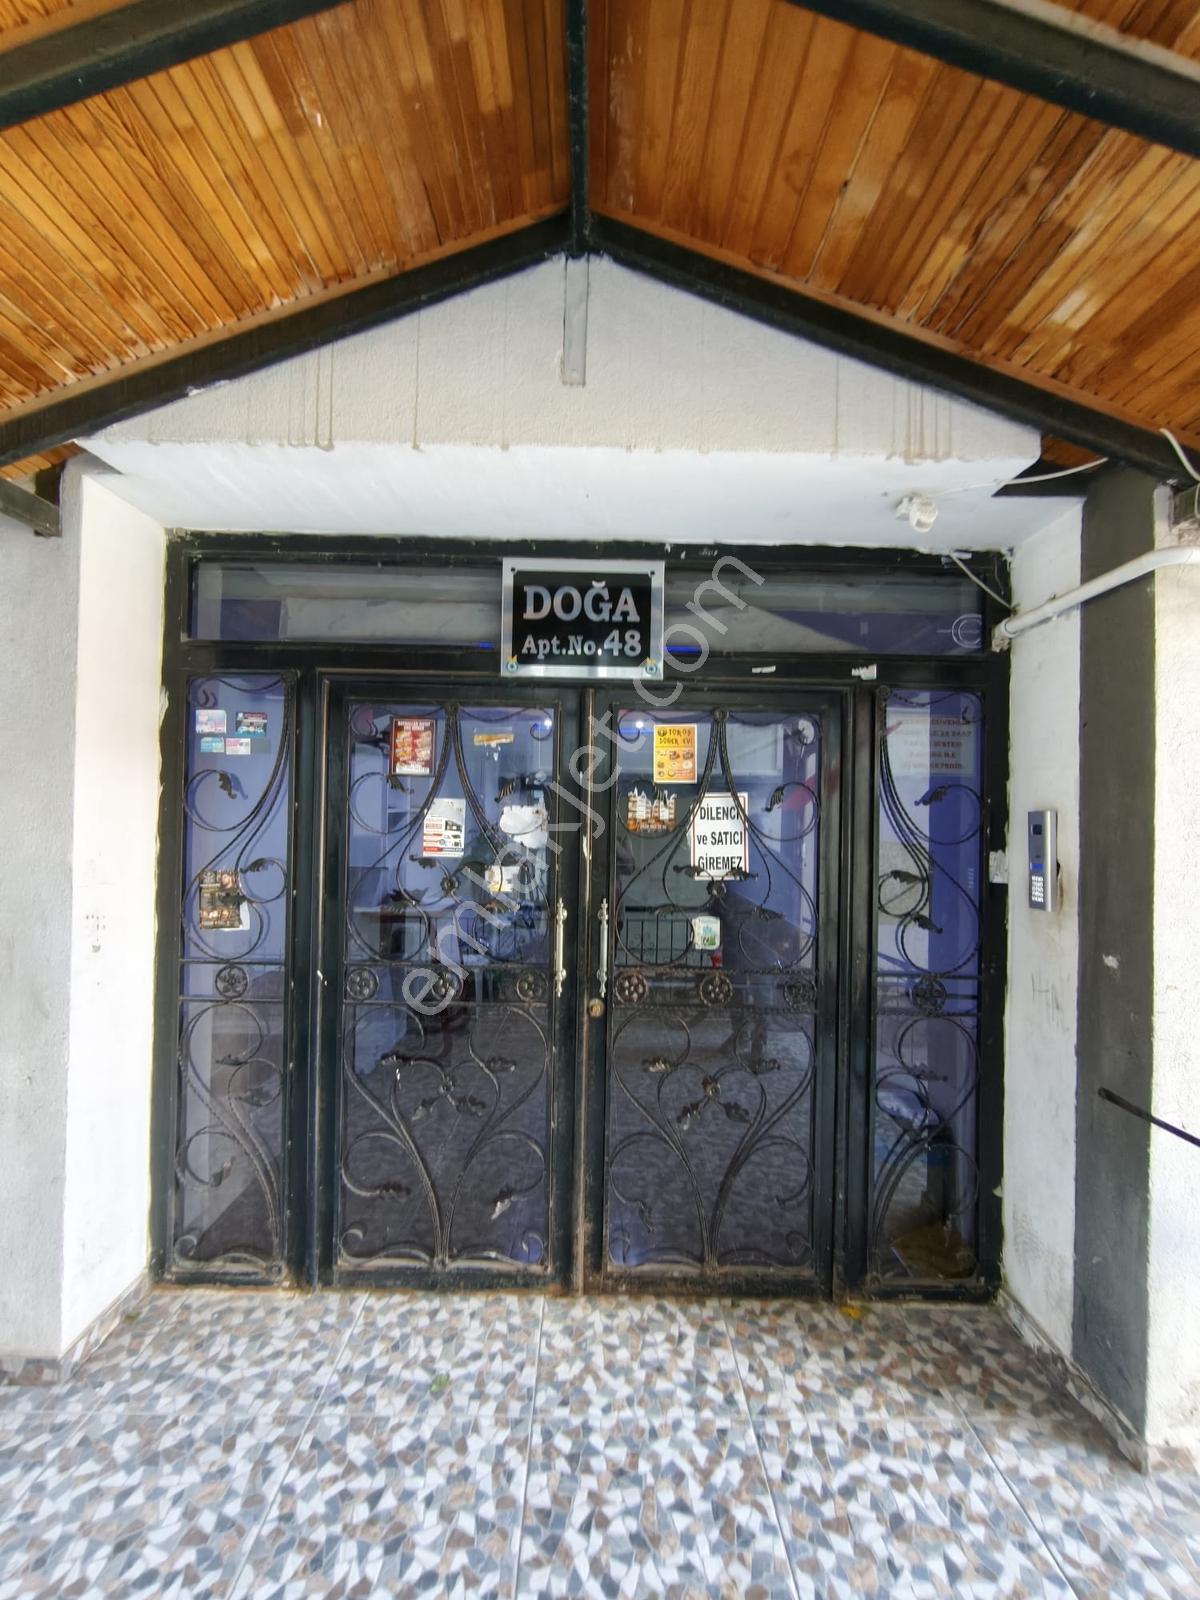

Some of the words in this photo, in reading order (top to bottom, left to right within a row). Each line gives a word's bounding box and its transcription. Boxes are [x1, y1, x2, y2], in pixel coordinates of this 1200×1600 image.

[523, 580, 641, 623] DOĞA
[696, 835, 708, 845] ve
[710, 831, 743, 846] SATICI
[697, 852, 743, 871] GİREMEZ
